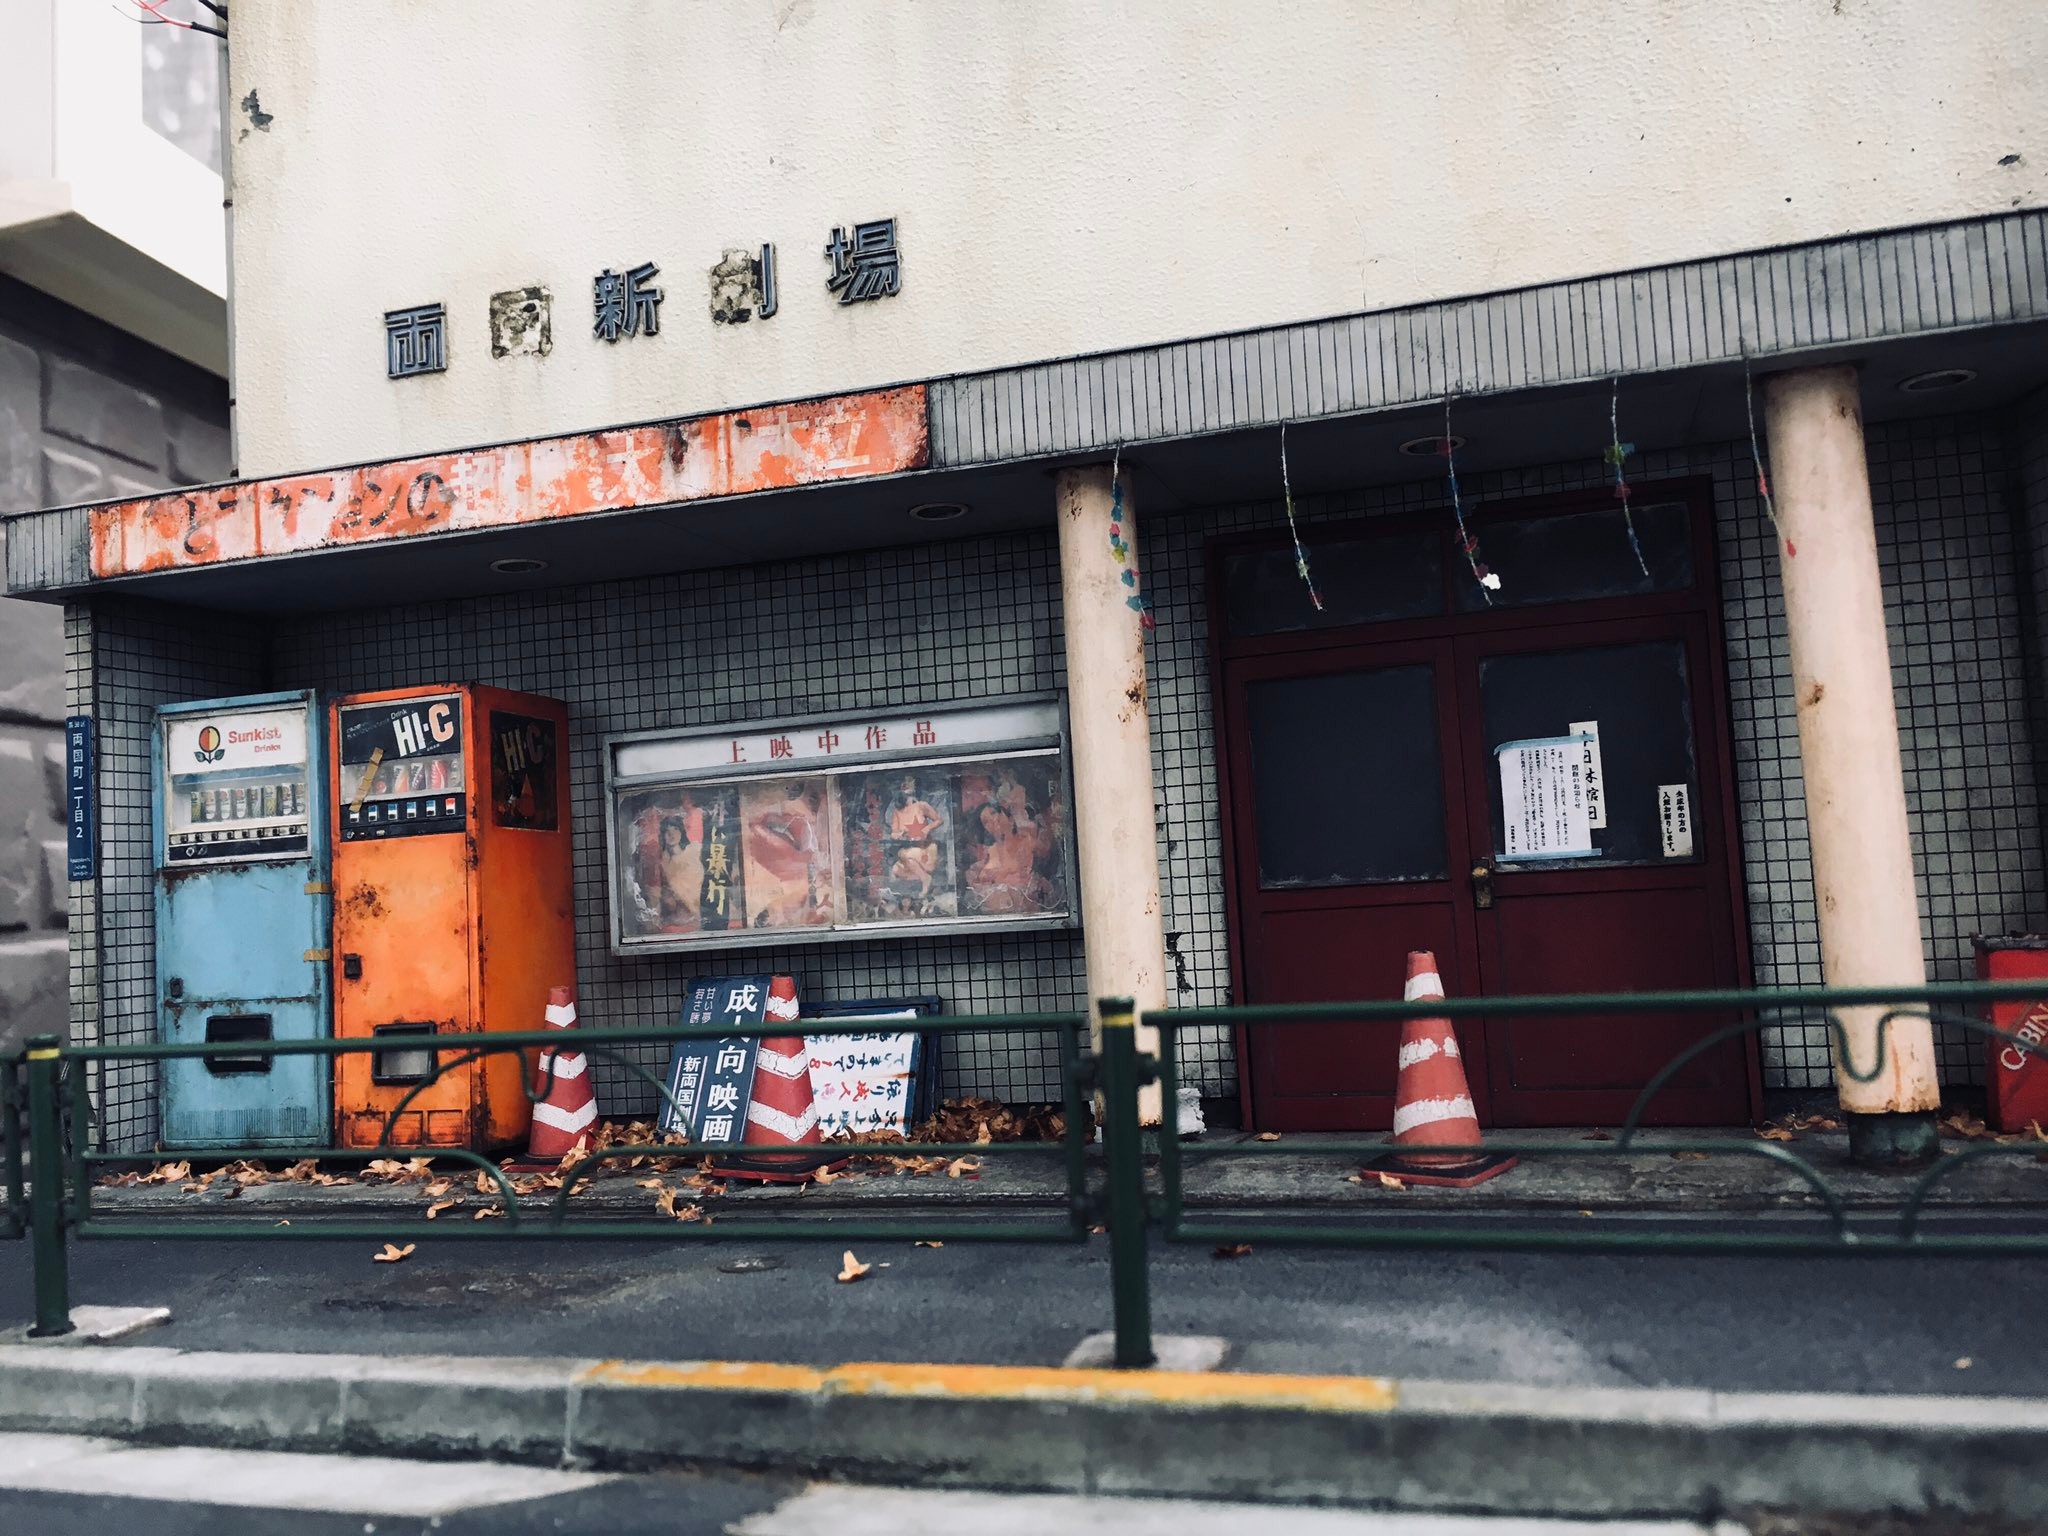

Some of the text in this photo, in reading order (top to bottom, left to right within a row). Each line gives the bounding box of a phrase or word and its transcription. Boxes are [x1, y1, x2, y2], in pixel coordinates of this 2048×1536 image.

[228, 727, 282, 744] Sunkist
[727, 720, 936, 764] 上映中作品
